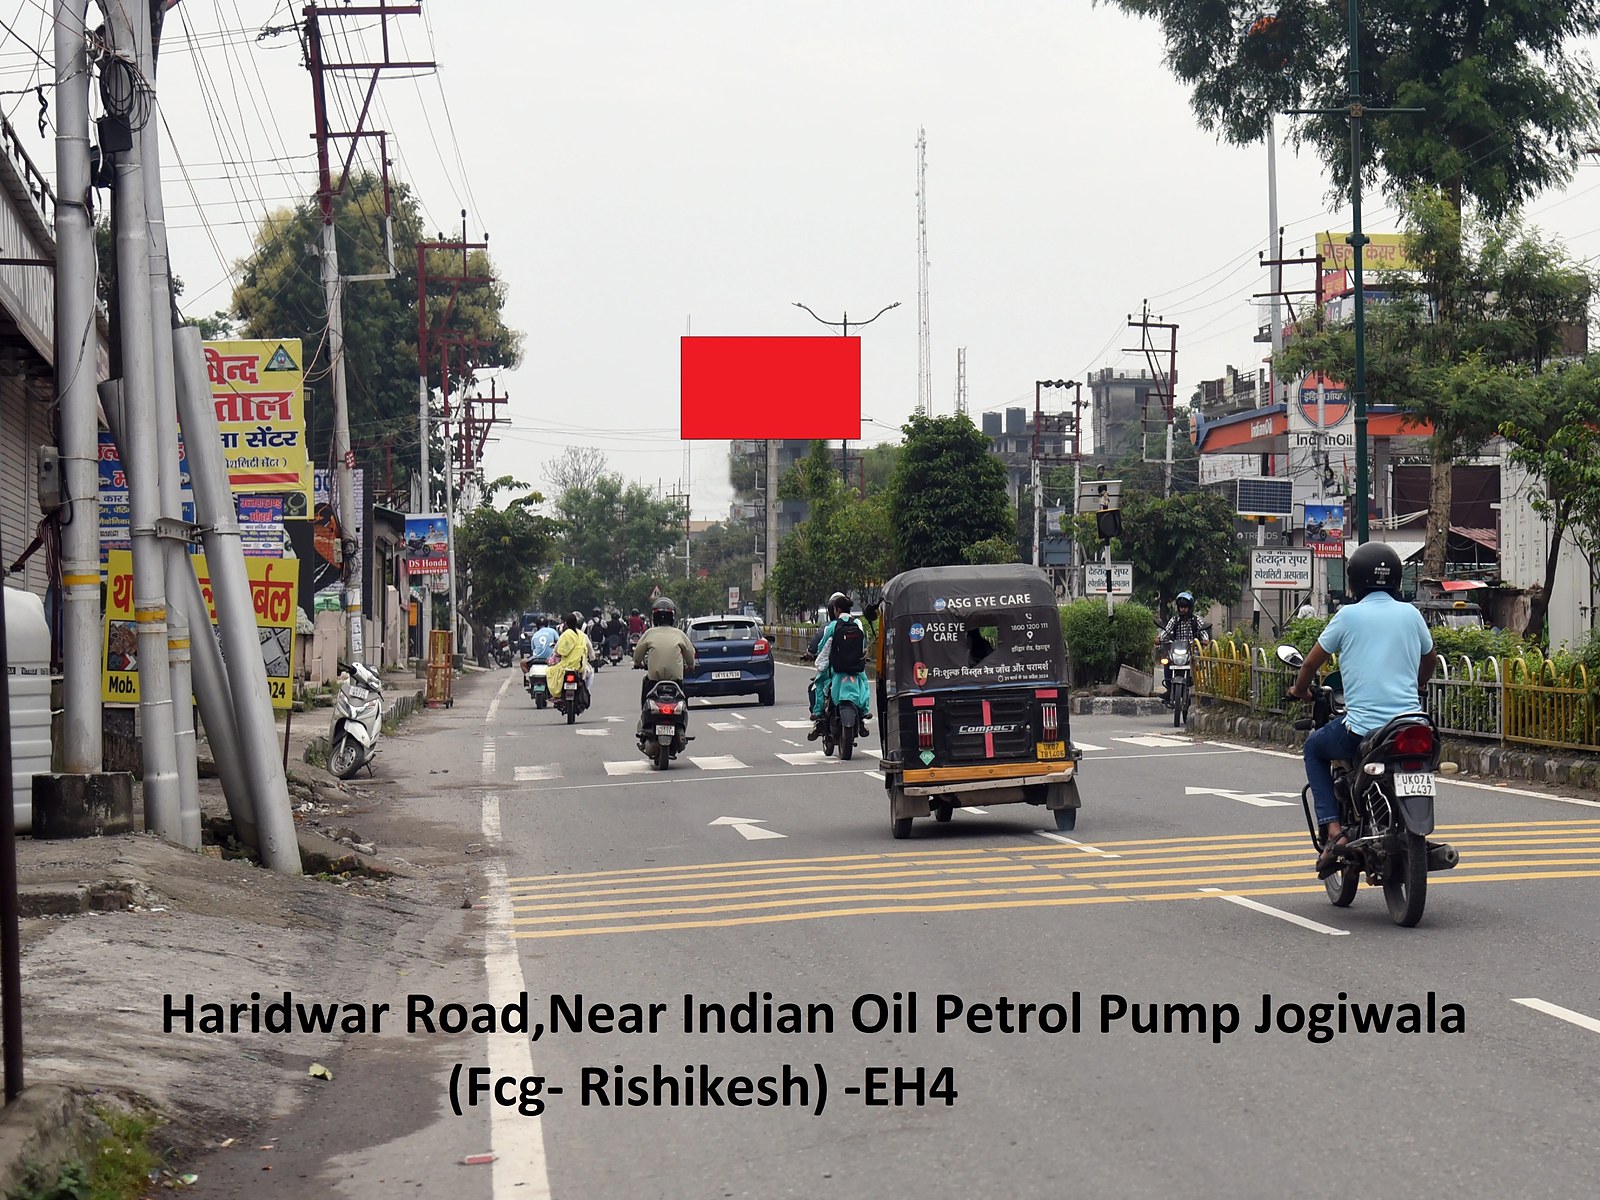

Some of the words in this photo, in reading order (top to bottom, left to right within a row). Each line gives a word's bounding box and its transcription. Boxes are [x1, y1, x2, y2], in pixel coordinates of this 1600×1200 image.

[203, 347, 260, 385] विन्द
[244, 426, 299, 448] सेंटर
[1296, 433, 1353, 446] IndanOil
[1244, 531, 1279, 540] TREDS
[1318, 543, 1342, 552] Honda
[408, 559, 421, 568] DS
[421, 558, 448, 567] Honda
[1255, 552, 1286, 567] देहरादून
[1288, 555, 1308, 567] सुपर
[947, 598, 971, 609] ASG
[975, 596, 997, 607] EYE
[999, 593, 1031, 606] CARE
[910, 627, 925, 637] asg
[926, 622, 946, 633] ASG
[948, 622, 965, 632] EYE
[539, 636, 547, 647] 9
[933, 632, 958, 642] CARE
[1012, 662, 1025, 672] और
[108, 675, 136, 694] Mob.
[1401, 774, 1432, 785] UK07A
[1403, 785, 1432, 795] L4437
